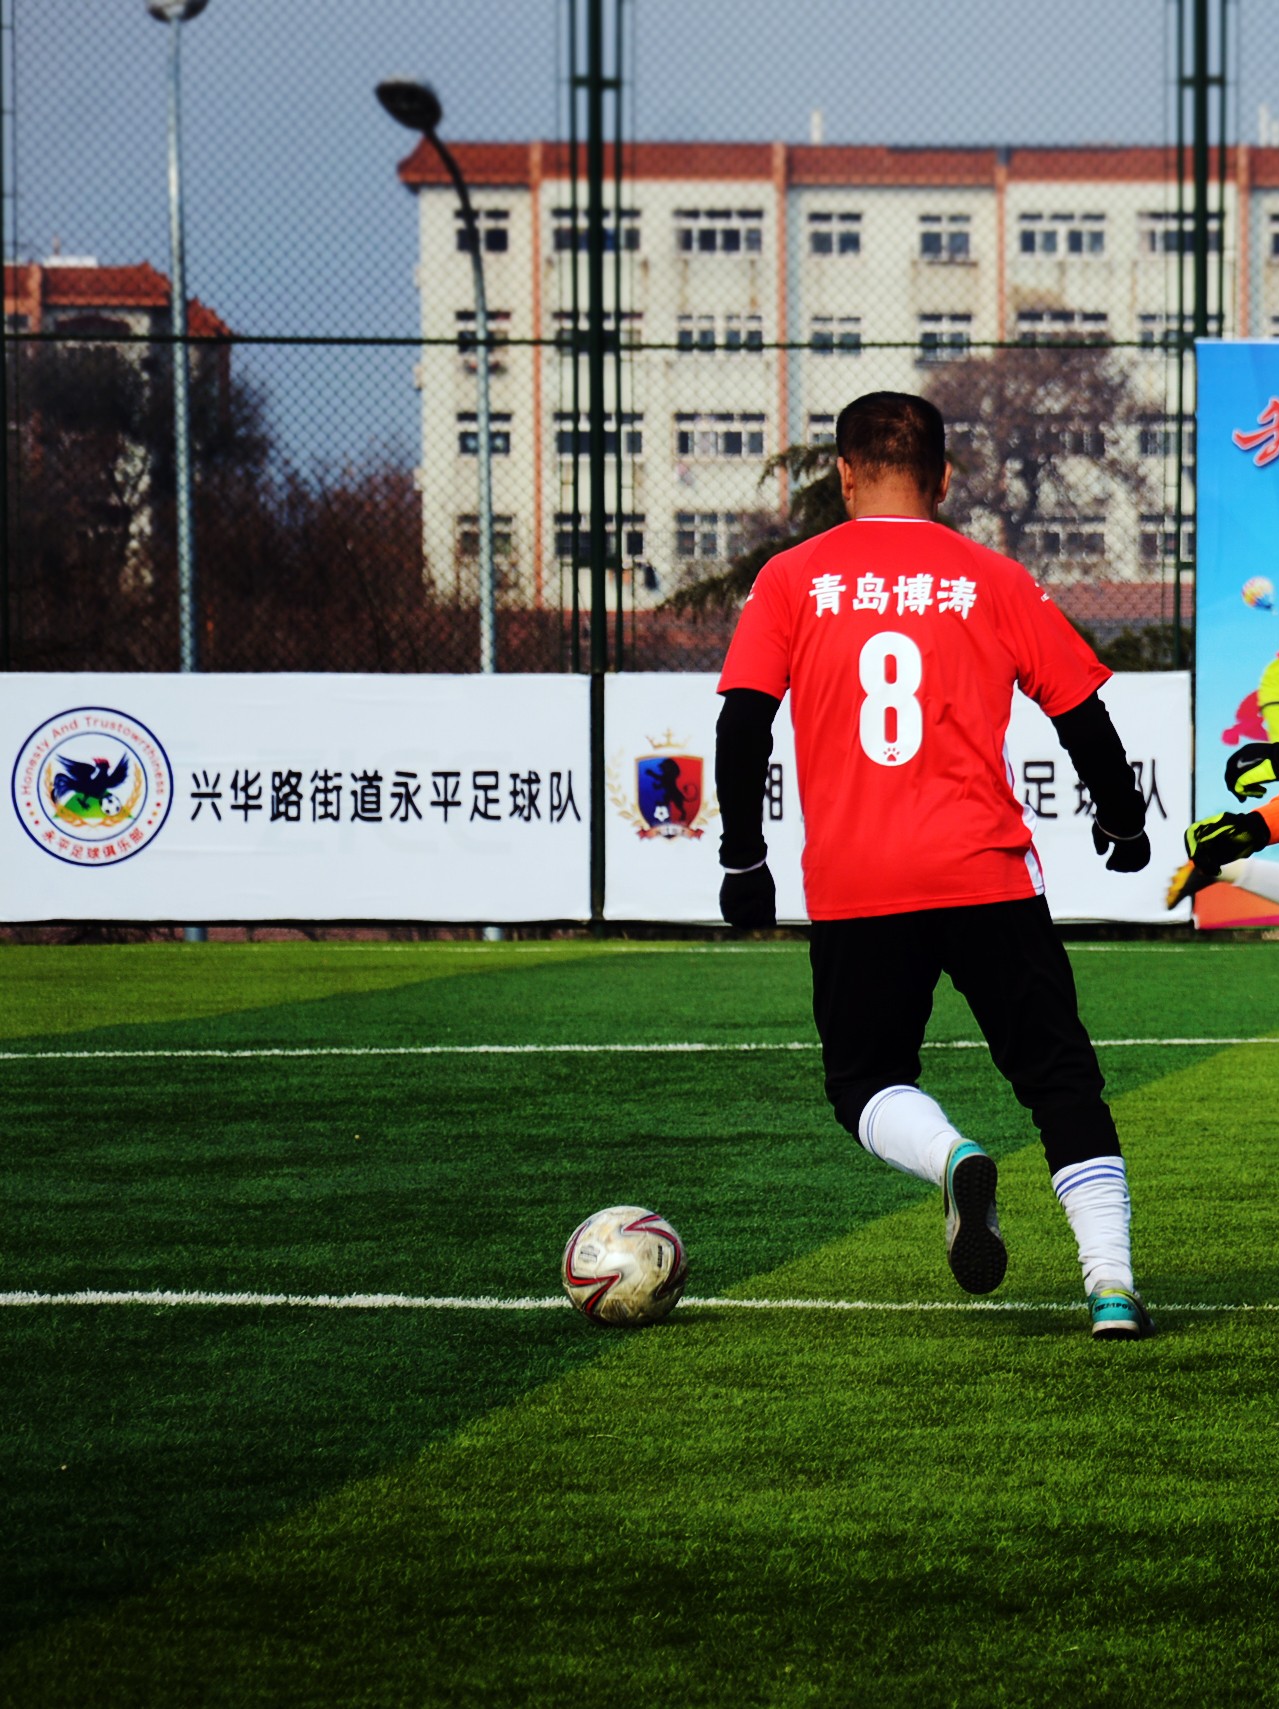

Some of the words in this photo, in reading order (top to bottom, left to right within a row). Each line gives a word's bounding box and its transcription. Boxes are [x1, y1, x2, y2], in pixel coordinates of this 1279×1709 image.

[808, 571, 978, 621] 青岛博涛
[857, 630, 924, 768] 8
[22, 738, 50, 795] Honesty
[52, 719, 79, 739] And
[190, 769, 583, 824] 兴华路街道永平足球队
[42, 827, 144, 860] 永平足球俱乐部
